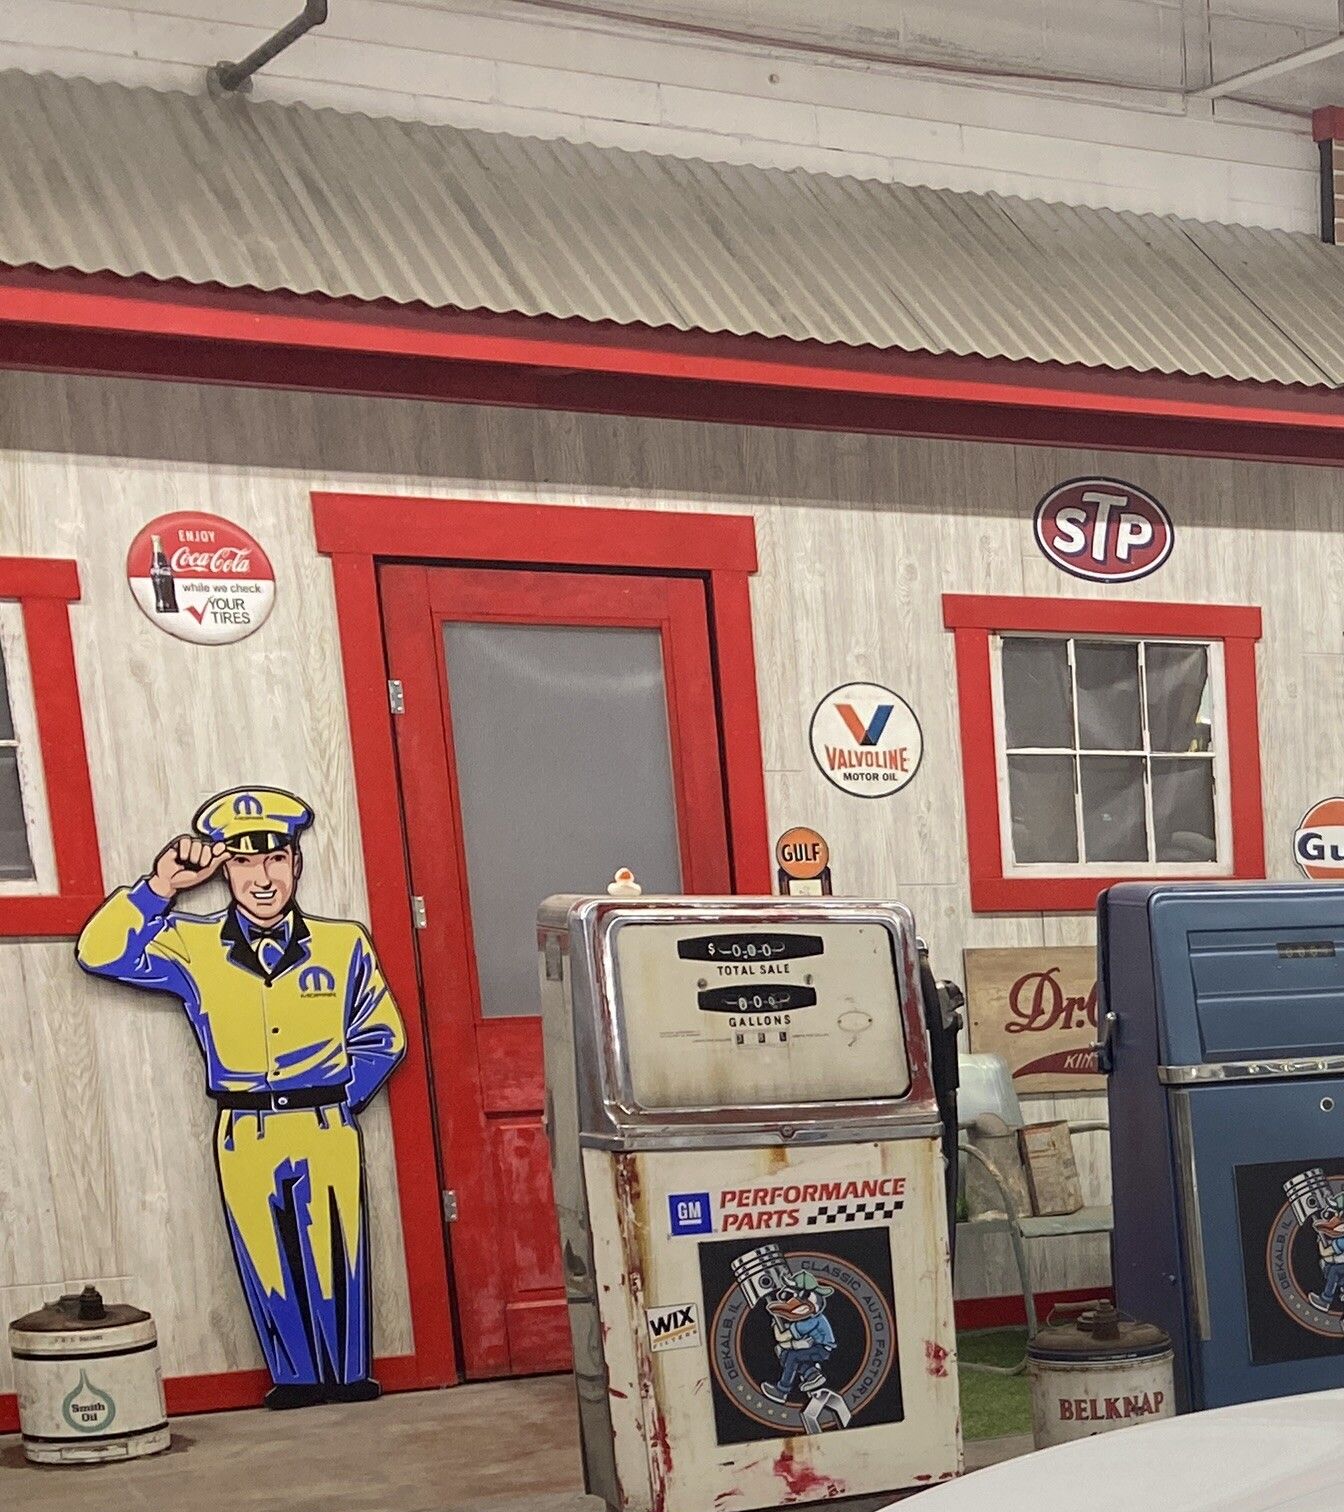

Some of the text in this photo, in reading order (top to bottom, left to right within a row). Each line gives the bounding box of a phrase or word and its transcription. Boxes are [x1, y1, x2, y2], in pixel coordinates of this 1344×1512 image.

[1053, 491, 1153, 562] STP
[178, 529, 215, 543] ENJOY
[182, 583, 262, 593] while we check
[209, 597, 246, 611] YOUR
[211, 611, 250, 624] TIRES
[824, 744, 911, 773] VALVOLINE
[843, 772, 898, 782] MOTOR OIL
[782, 842, 820, 863] GULF
[717, 963, 790, 976] TOTAL SALE
[729, 1014, 791, 1027] GALLONS
[1063, 1051, 1098, 1069] KIN
[677, 1178, 906, 1220] GM PERFORMANCE
[721, 1209, 801, 1233] PARTS
[728, 1301, 741, 1314] IL
[650, 1306, 695, 1336] WIX
[801, 1260, 886, 1403] CLASSIC AUTO FACTORY
[71, 1402, 105, 1413] Smith
[1058, 1391, 1164, 1421] BELKNAP
[81, 1412, 98, 1422] Oil
